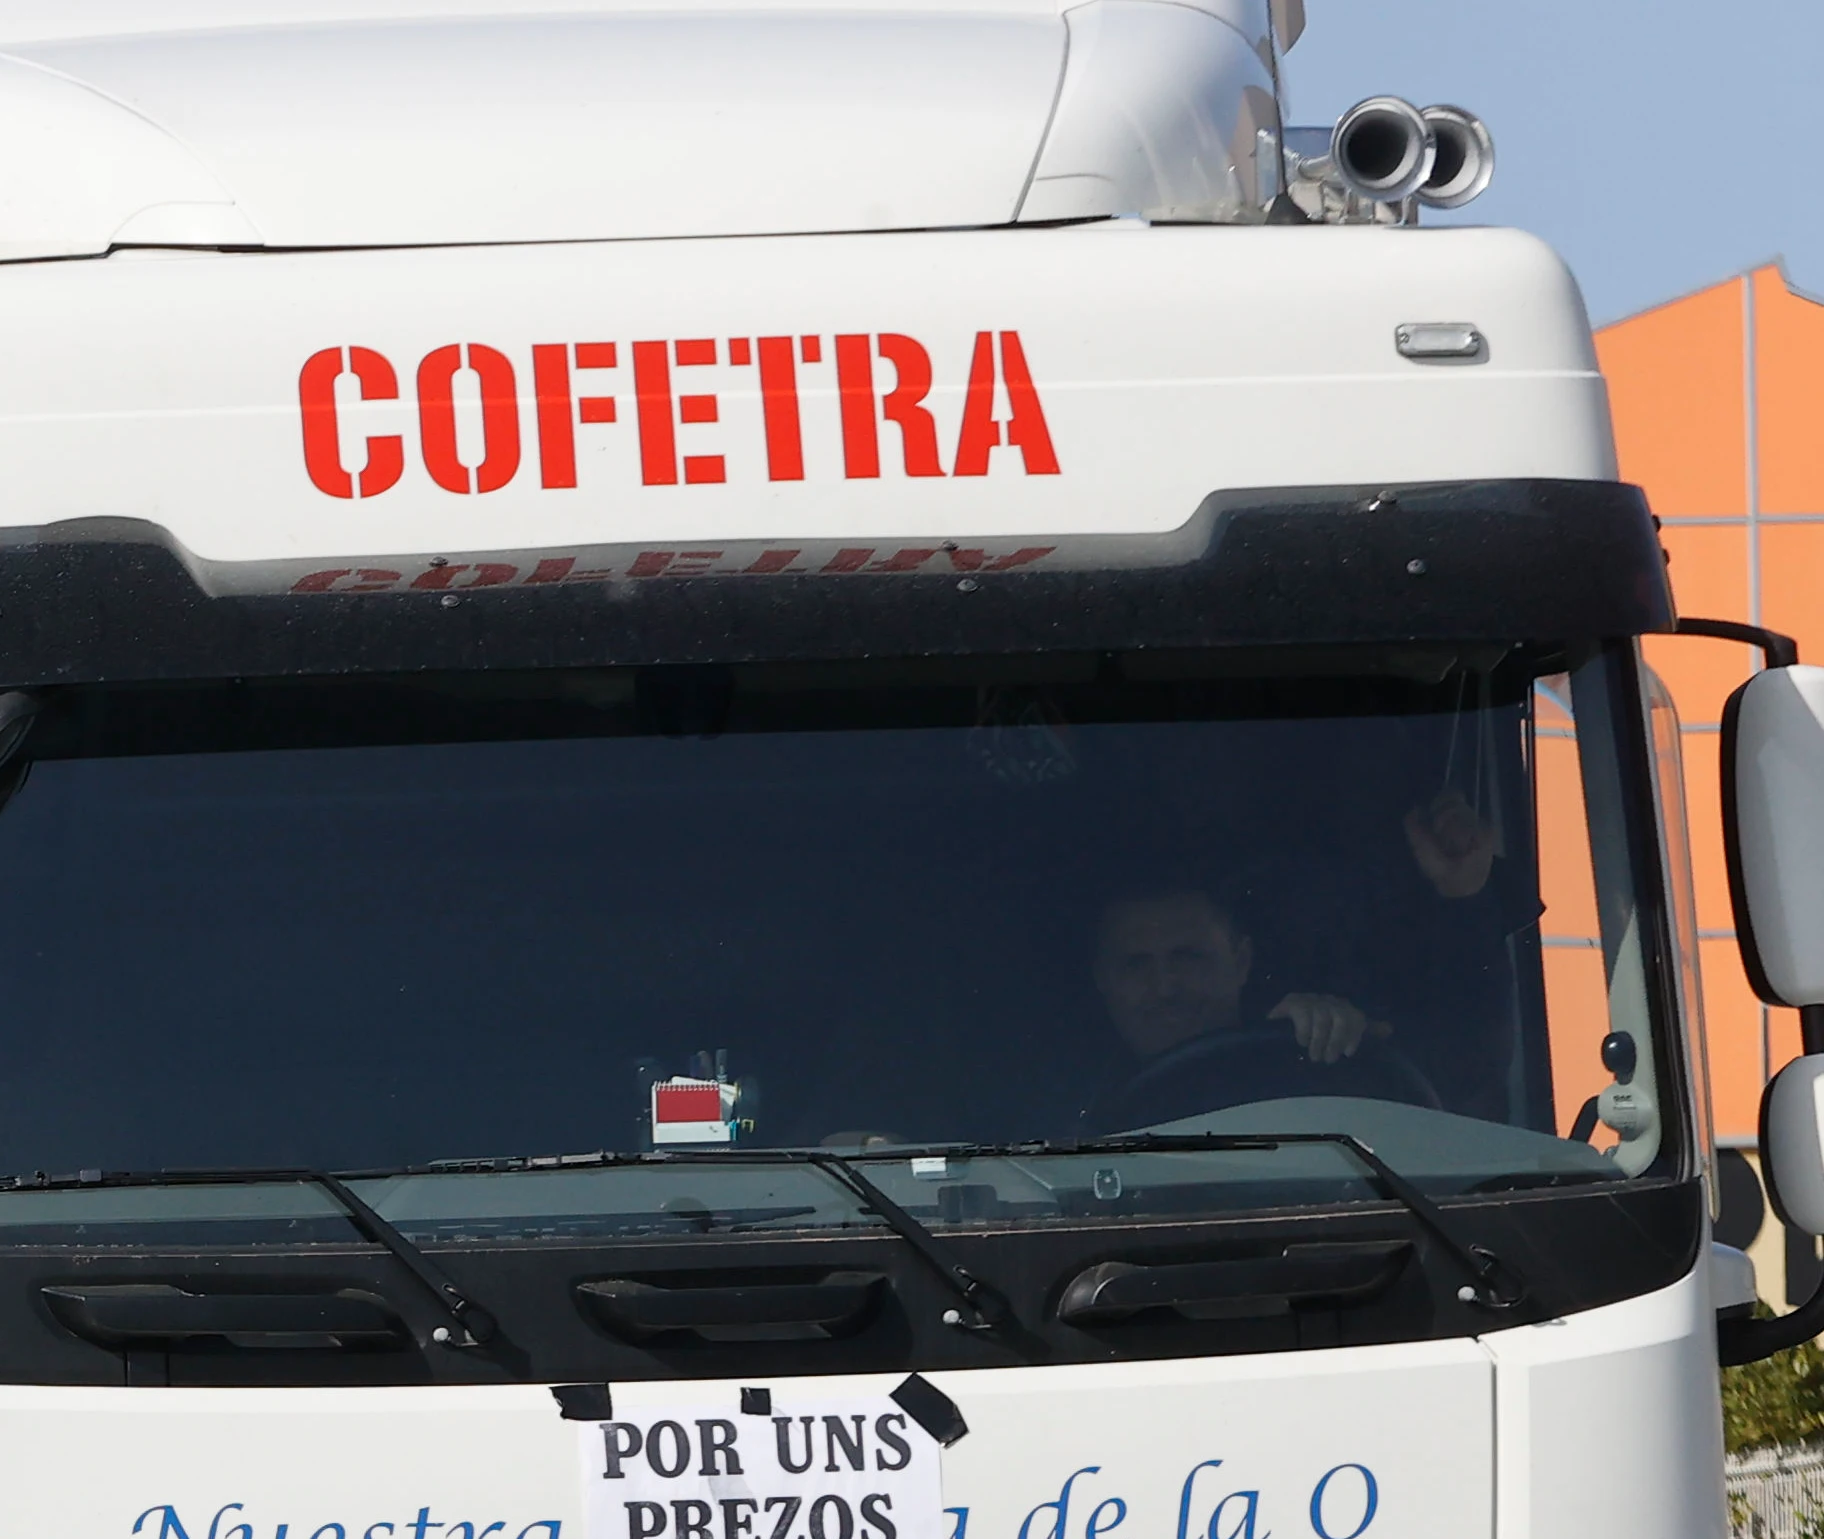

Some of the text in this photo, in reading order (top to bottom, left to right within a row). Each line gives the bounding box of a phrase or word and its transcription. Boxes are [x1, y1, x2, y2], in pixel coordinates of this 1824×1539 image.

[298, 330, 1062, 499] COFETRA
[599, 1413, 912, 1479] POR UNS
